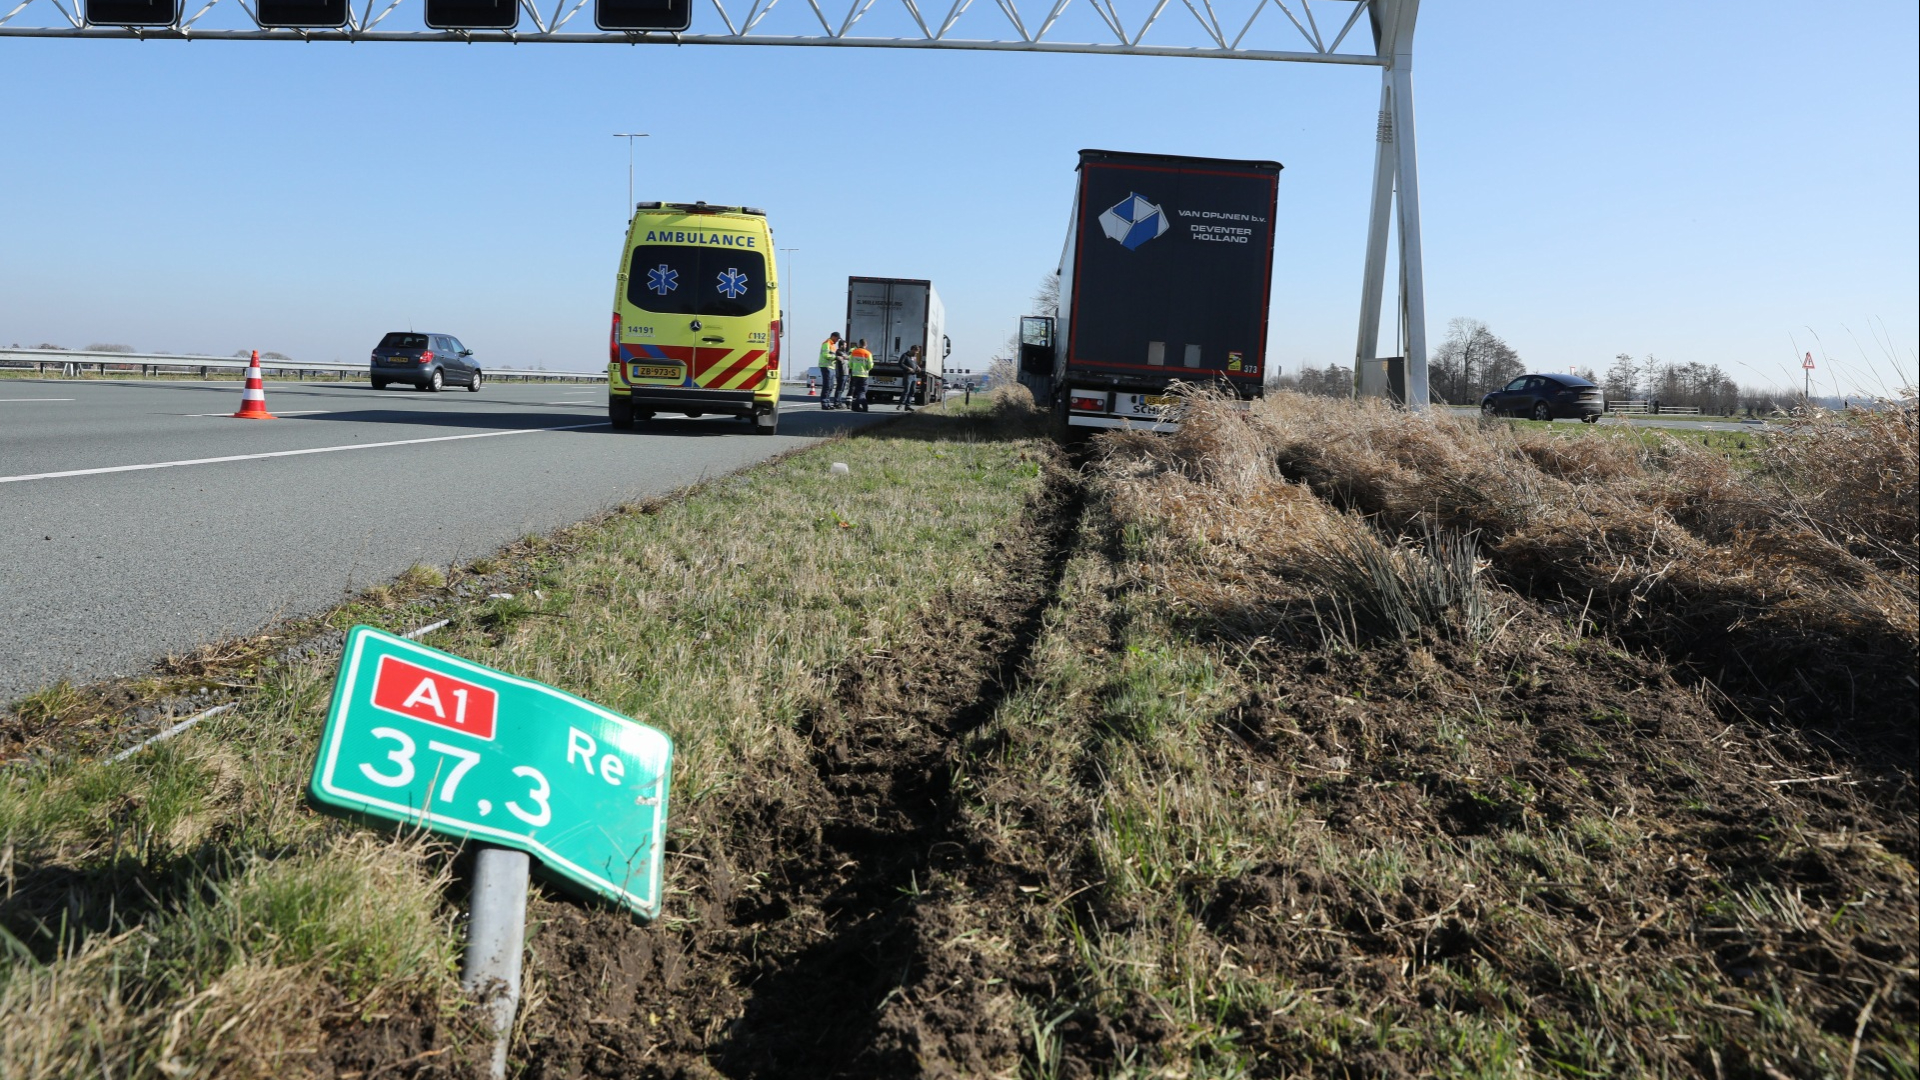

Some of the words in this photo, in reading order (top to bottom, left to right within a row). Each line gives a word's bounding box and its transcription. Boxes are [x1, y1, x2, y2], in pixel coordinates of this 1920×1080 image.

[1178, 209, 1200, 218] VAN
[1202, 211, 1250, 221] OPIJNEN
[1190, 224, 1252, 235] DEVENTER
[646, 230, 756, 248] AMBULANCE
[1193, 233, 1248, 244] HOLLAND
[628, 325, 654, 334] 14191
[753, 332, 767, 340] 112
[1243, 364, 1258, 374] 373
[403, 677, 468, 724] A1
[566, 726, 625, 786] Re
[358, 727, 552, 827] 37,3
